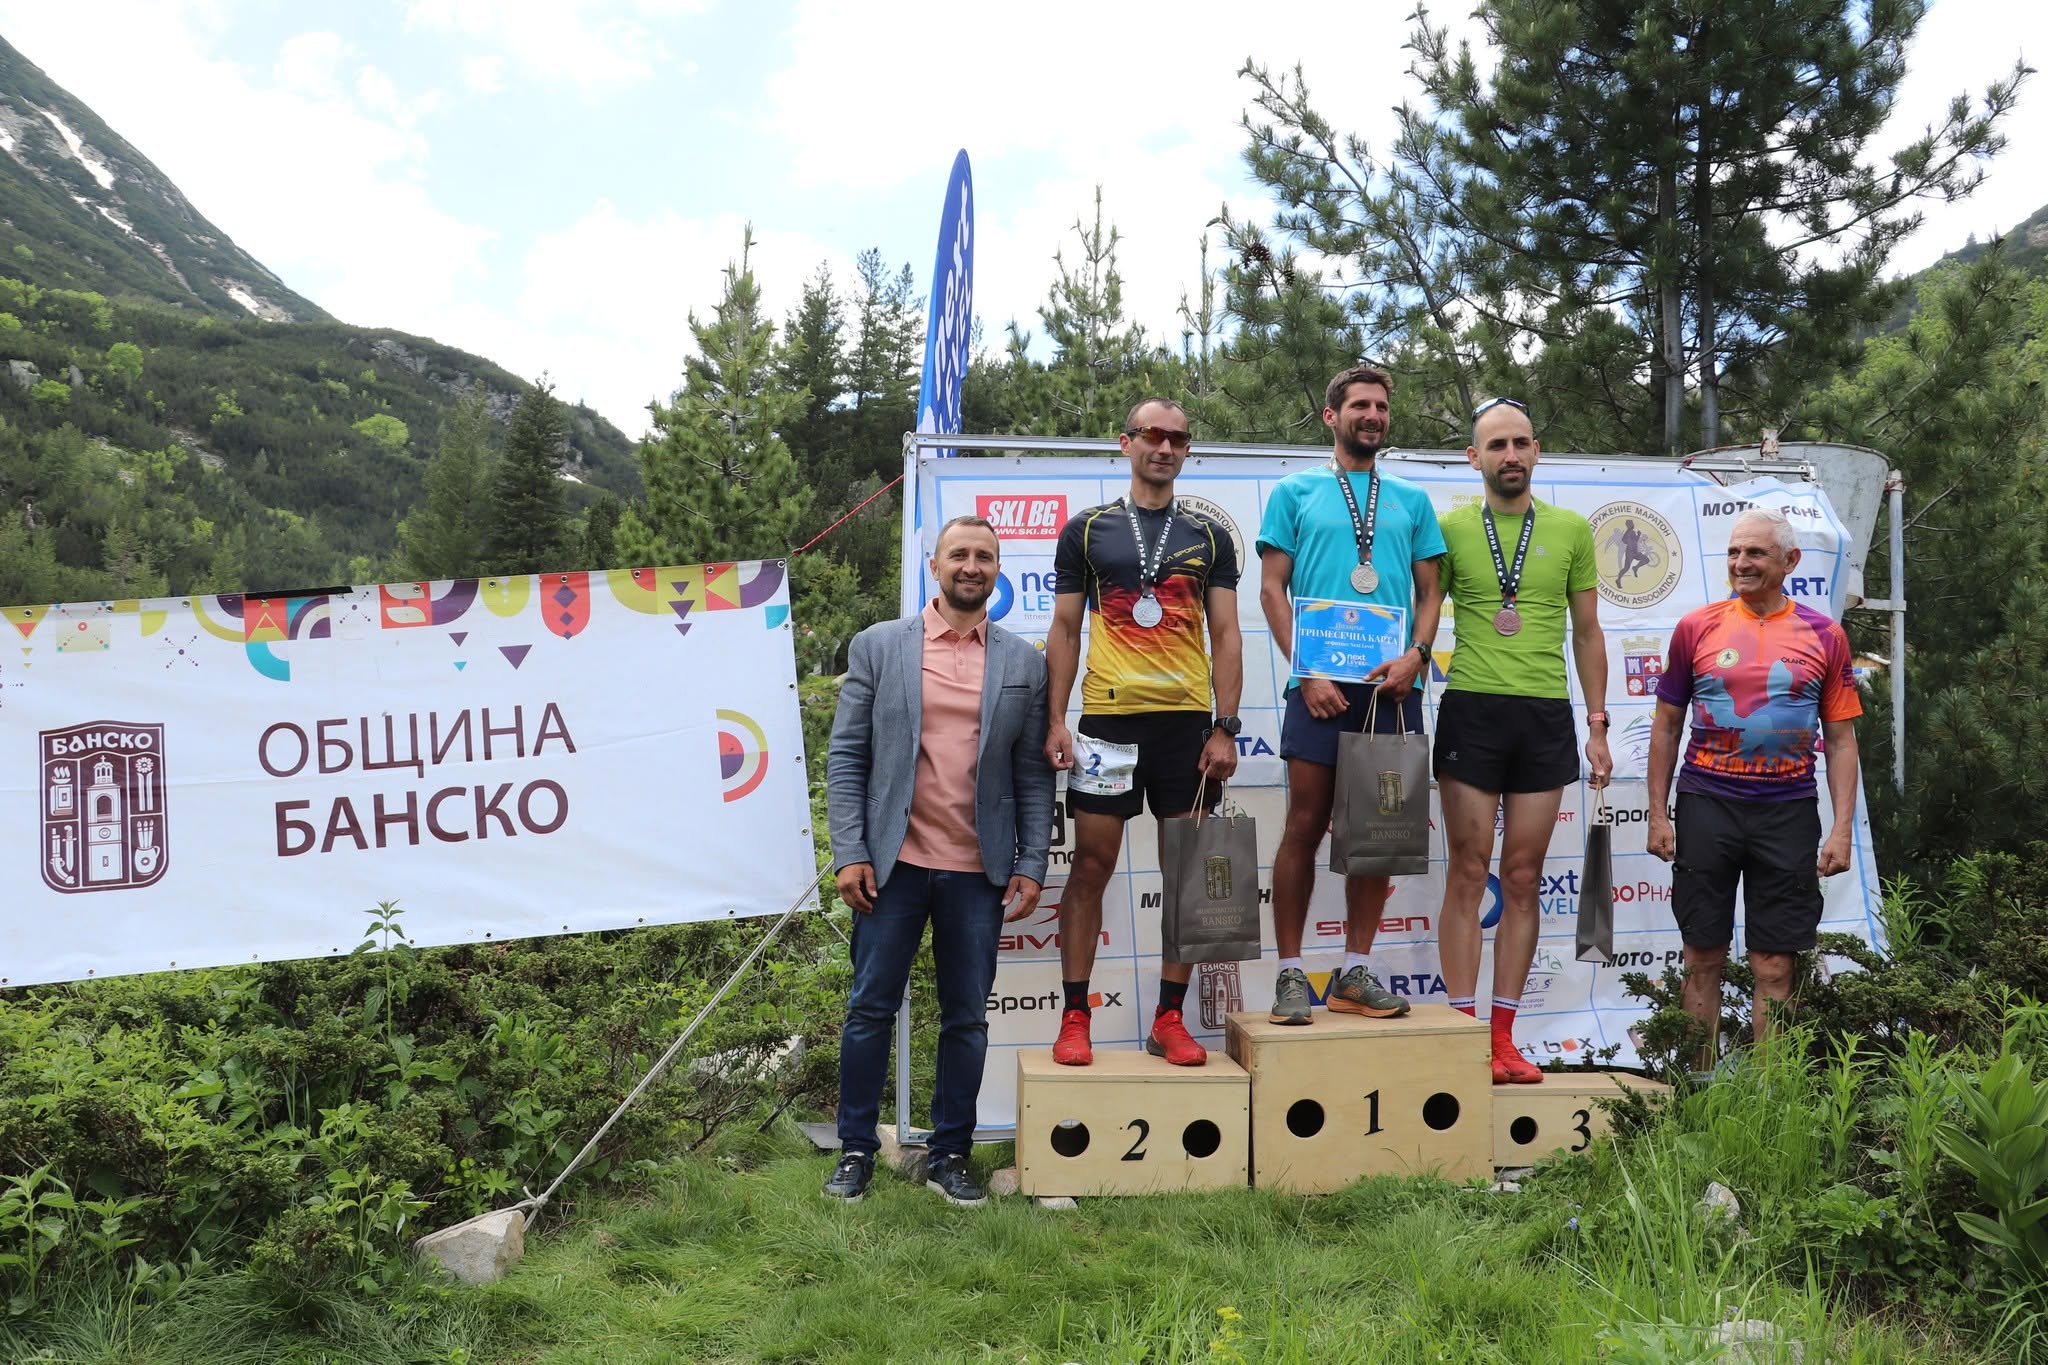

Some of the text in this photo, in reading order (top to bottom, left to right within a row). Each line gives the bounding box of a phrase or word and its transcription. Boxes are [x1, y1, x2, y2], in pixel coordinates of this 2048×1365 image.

[1635, 507, 1672, 537] МАРАТОН
[1021, 572, 1056, 592] ne
[1598, 571, 1677, 605] RATHON ASSOCIATION
[1300, 628, 1398, 646] ТРИМЕСЕЧНА КАРТА
[52, 732, 153, 755] БАНСКО
[258, 702, 577, 779] ОБЩИНА
[1086, 753, 1102, 777] 2
[275, 779, 569, 857] БАНСКО
[1371, 830, 1411, 841] BANSKO
[1202, 914, 1242, 926] BANSKO
[1202, 963, 1236, 973] БАНСКО
[1364, 1089, 1384, 1136] 1
[1120, 1118, 1150, 1161] 2
[1571, 1108, 1592, 1153] 3
